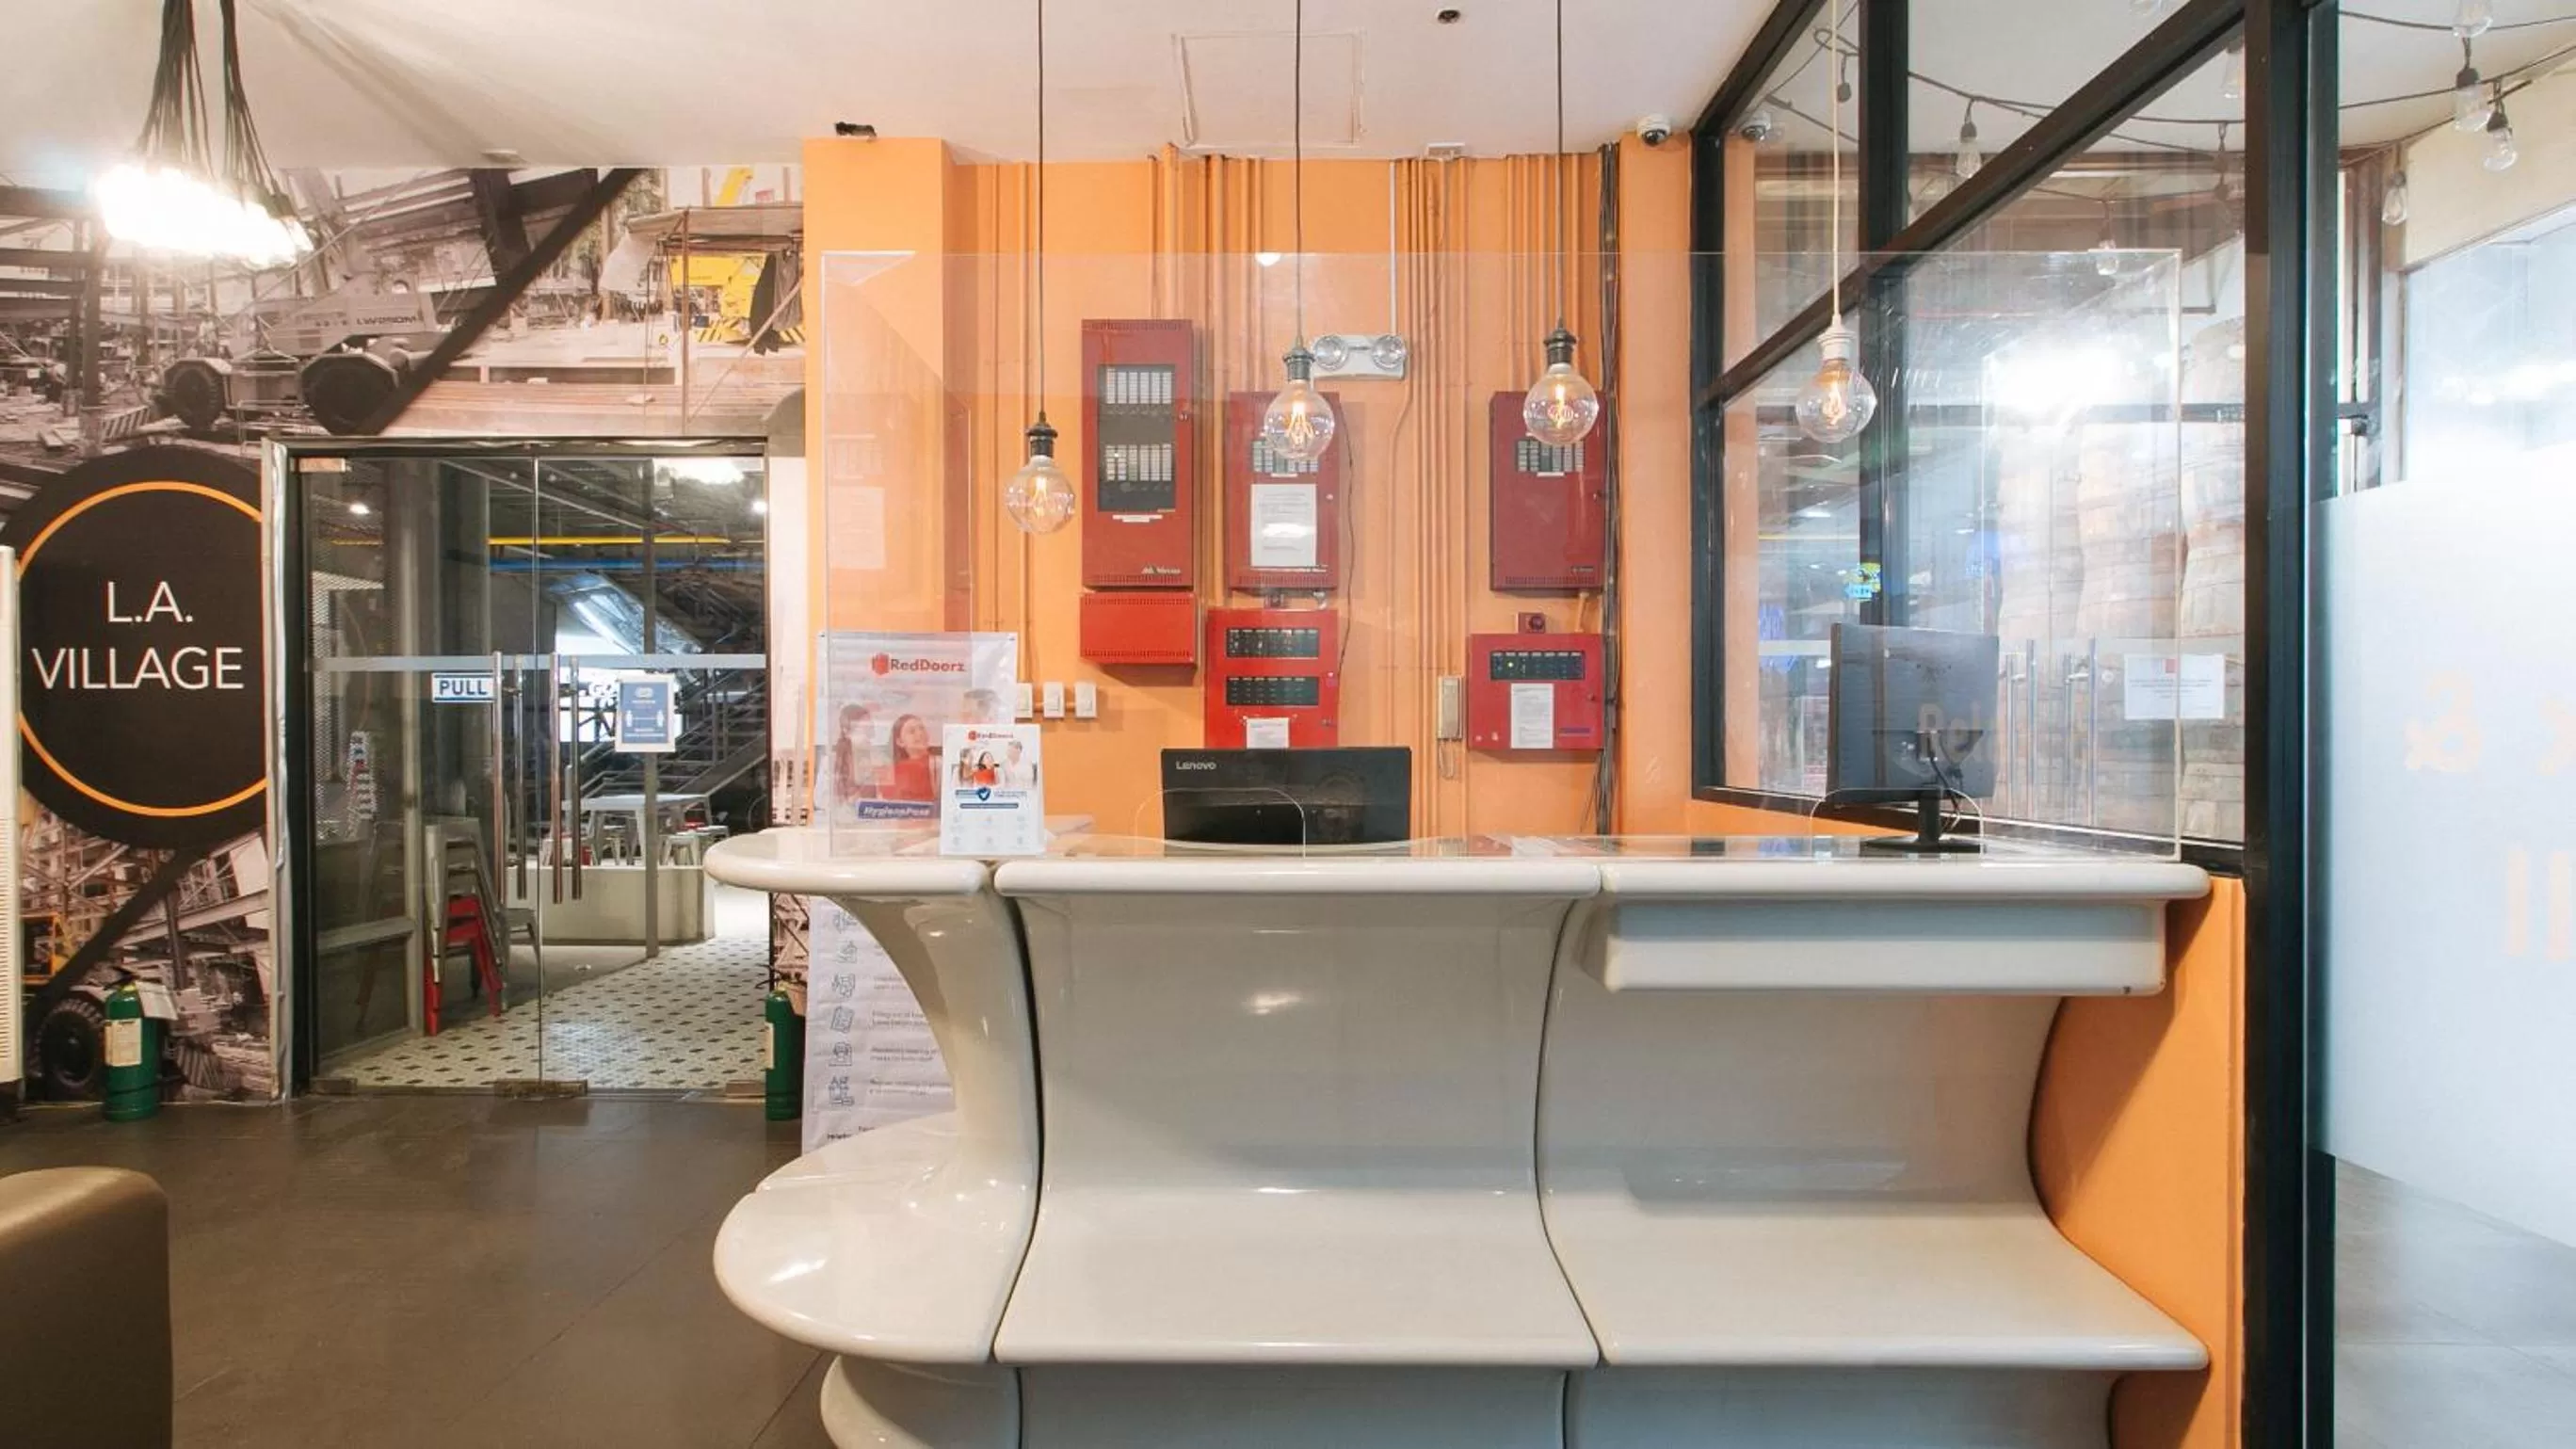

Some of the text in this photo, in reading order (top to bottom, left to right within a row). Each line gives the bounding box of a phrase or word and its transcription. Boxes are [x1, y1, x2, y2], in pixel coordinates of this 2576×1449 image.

[107, 581, 193, 622] L.A.
[31, 646, 244, 689] VILLAGE
[891, 658, 965, 672] RedDoorz
[439, 680, 488, 696] PULL
[1176, 760, 1217, 770] Lenovo
